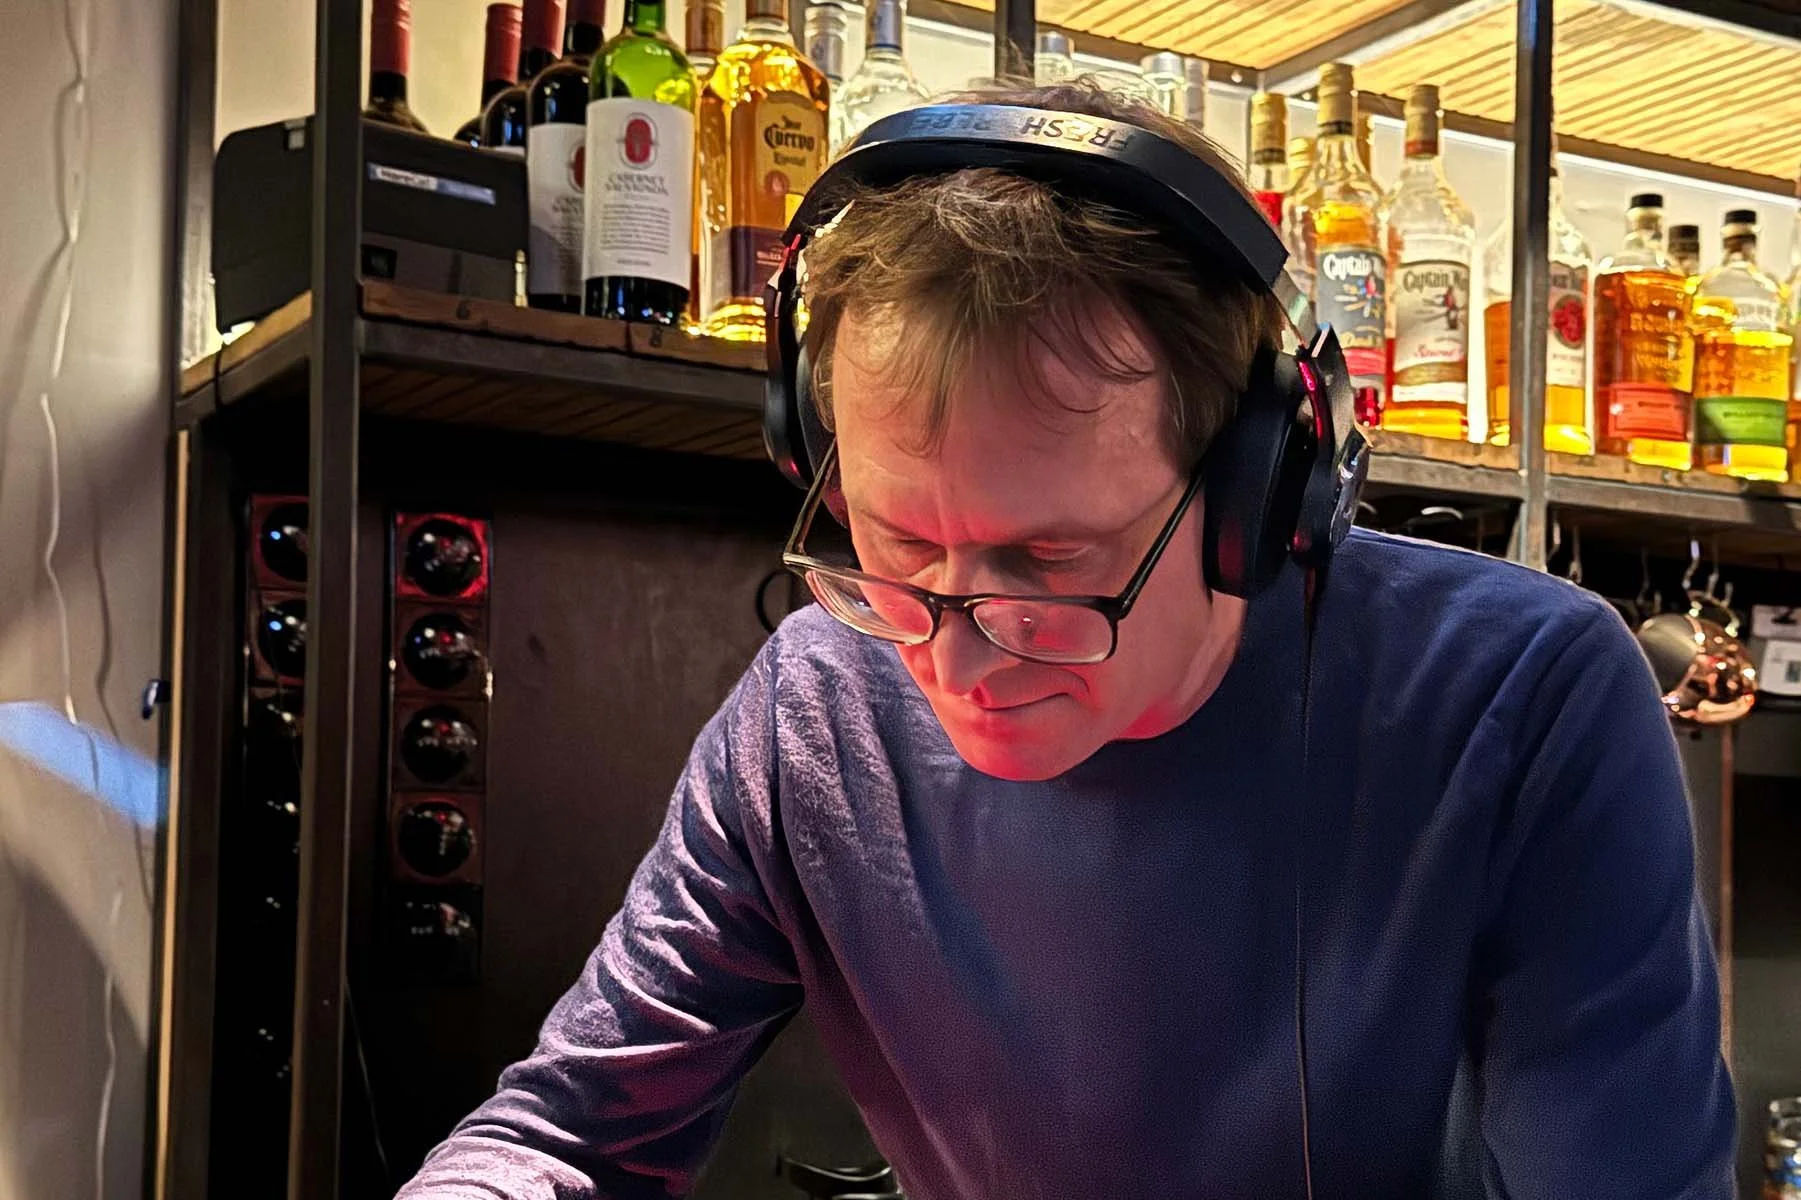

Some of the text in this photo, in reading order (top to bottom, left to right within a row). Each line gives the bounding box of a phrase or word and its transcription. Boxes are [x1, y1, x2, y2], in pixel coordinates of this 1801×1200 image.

[763, 122, 816, 151] Cuervo
[1020, 116, 1134, 152] FRESH
[1403, 270, 1449, 293] Captain
